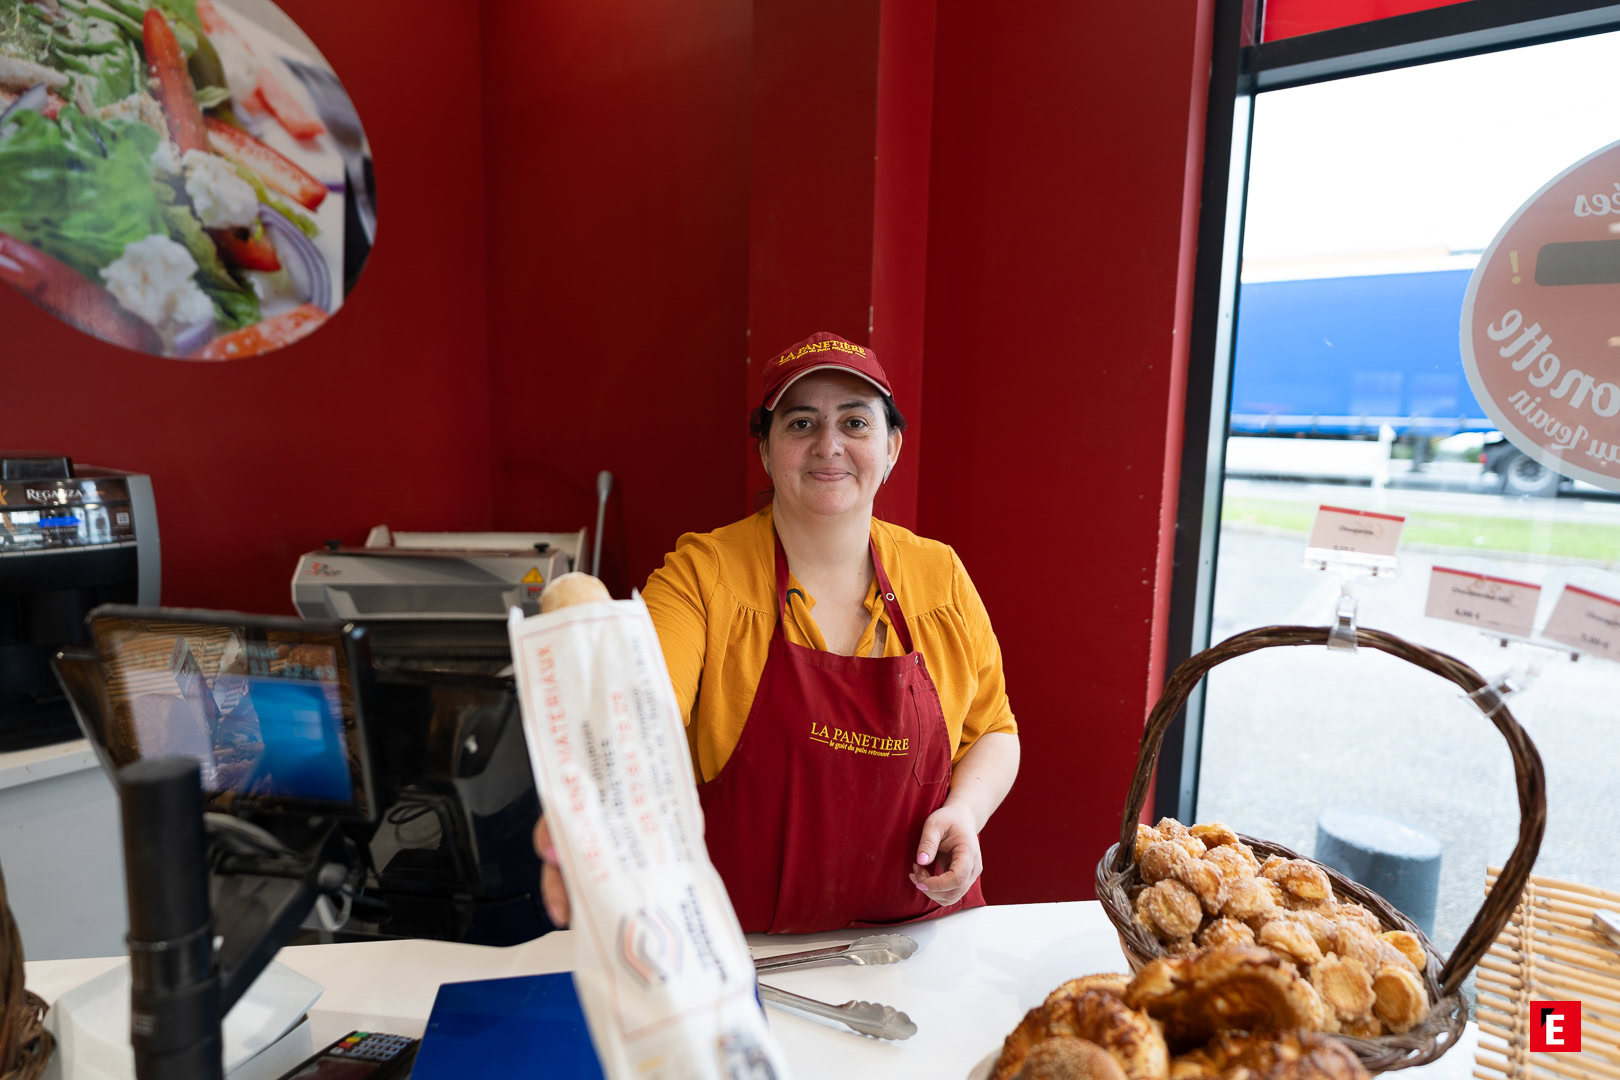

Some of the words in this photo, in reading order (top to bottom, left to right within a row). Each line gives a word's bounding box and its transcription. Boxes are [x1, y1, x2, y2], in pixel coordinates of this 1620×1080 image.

[779, 351, 796, 363] LA
[811, 722, 829, 738] LA
[833, 728, 909, 751] PANETIÈRE
